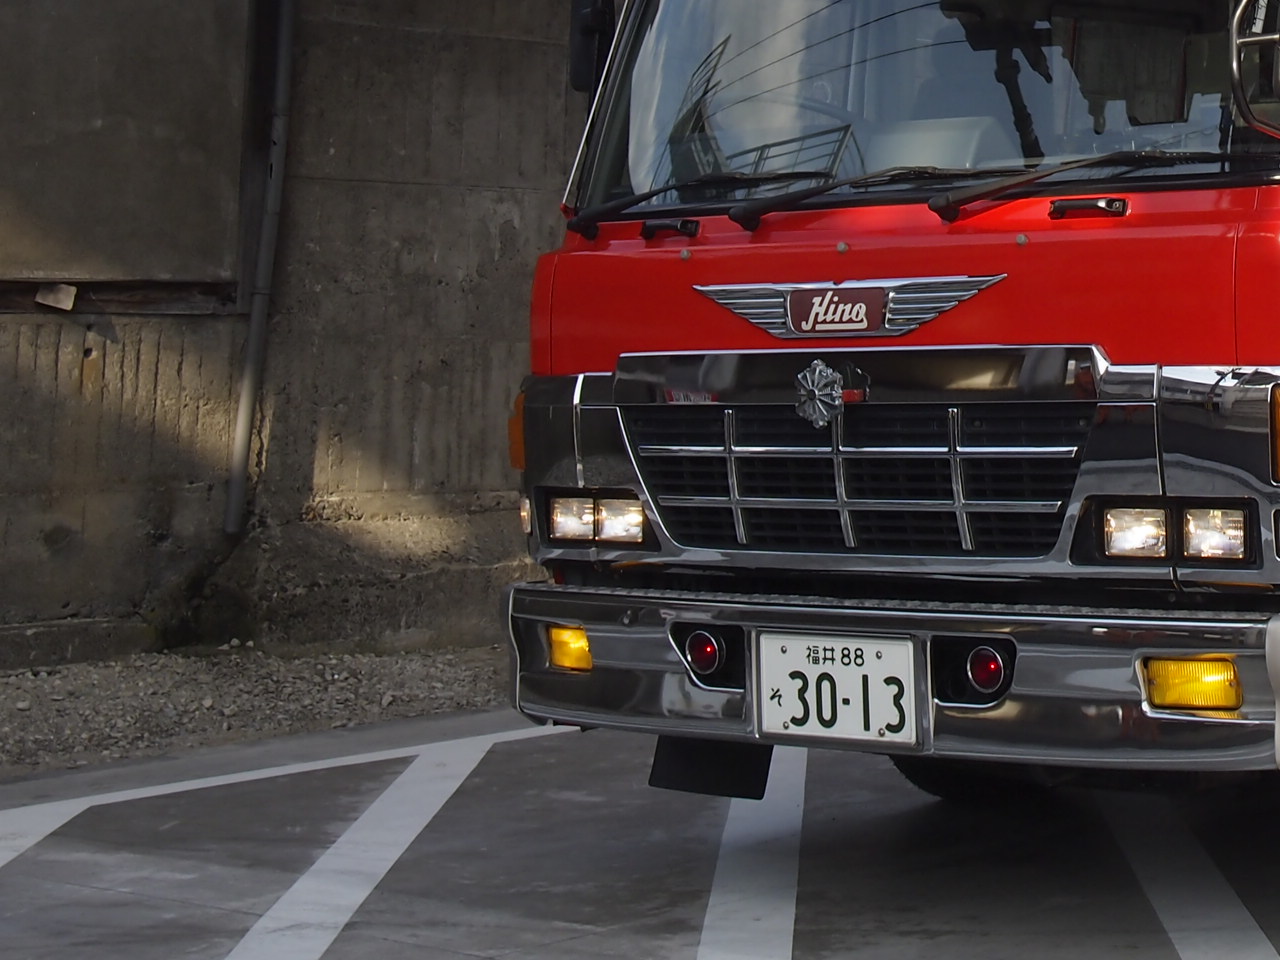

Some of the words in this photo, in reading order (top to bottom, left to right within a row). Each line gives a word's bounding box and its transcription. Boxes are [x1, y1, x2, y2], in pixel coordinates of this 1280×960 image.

[801, 290, 868, 331] Hino
[769, 687, 783, 708] そ
[788, 670, 906, 734] 30-13
